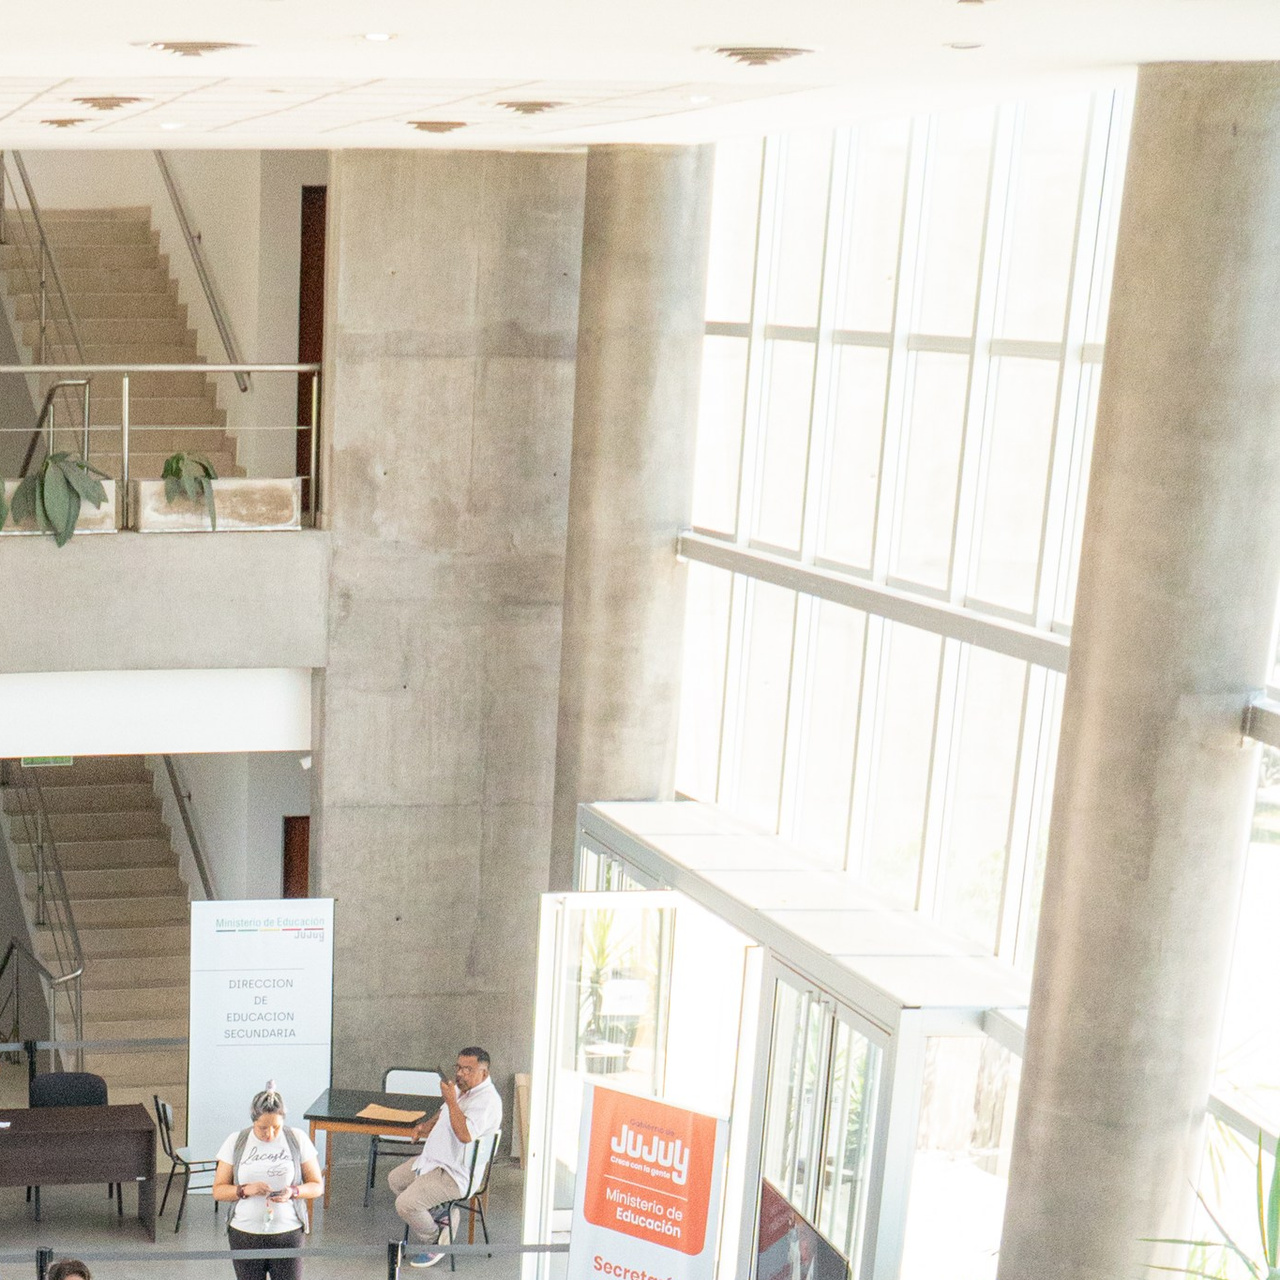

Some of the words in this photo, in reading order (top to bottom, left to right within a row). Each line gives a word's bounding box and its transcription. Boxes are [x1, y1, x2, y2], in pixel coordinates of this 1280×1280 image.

[215, 918, 261, 928] Ministerio
[263, 918, 274, 927] de
[277, 916, 325, 927] Educación
[228, 978, 294, 989] DIRECCION
[253, 995, 268, 1005] DE
[226, 1011, 295, 1022] EDUCACION
[223, 1028, 297, 1039] SECUNDARIA
[605, 1186, 664, 1216] Ministerio
[666, 1206, 684, 1222] de
[616, 1207, 682, 1239] Educación
